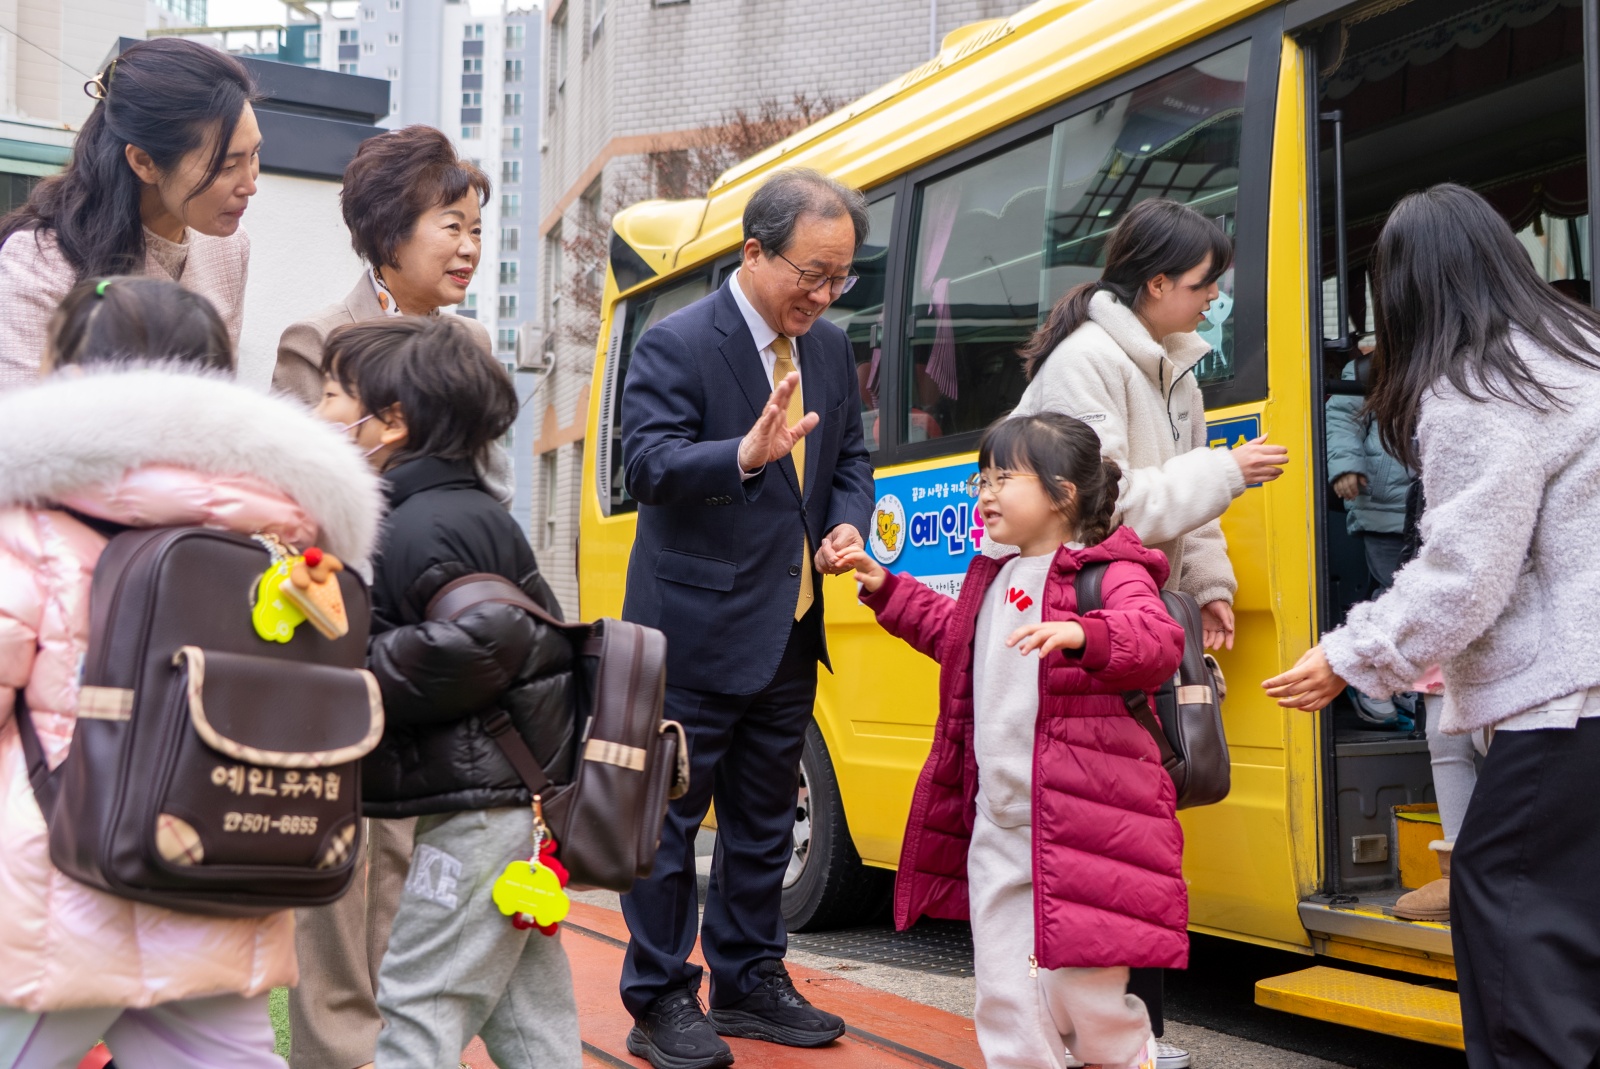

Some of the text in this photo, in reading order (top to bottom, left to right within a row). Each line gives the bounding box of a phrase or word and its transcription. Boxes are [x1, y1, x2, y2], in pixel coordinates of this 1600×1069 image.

[912, 480, 970, 502] 꿈과 사랑을 키우
[211, 765, 341, 801] 예인 유치원
